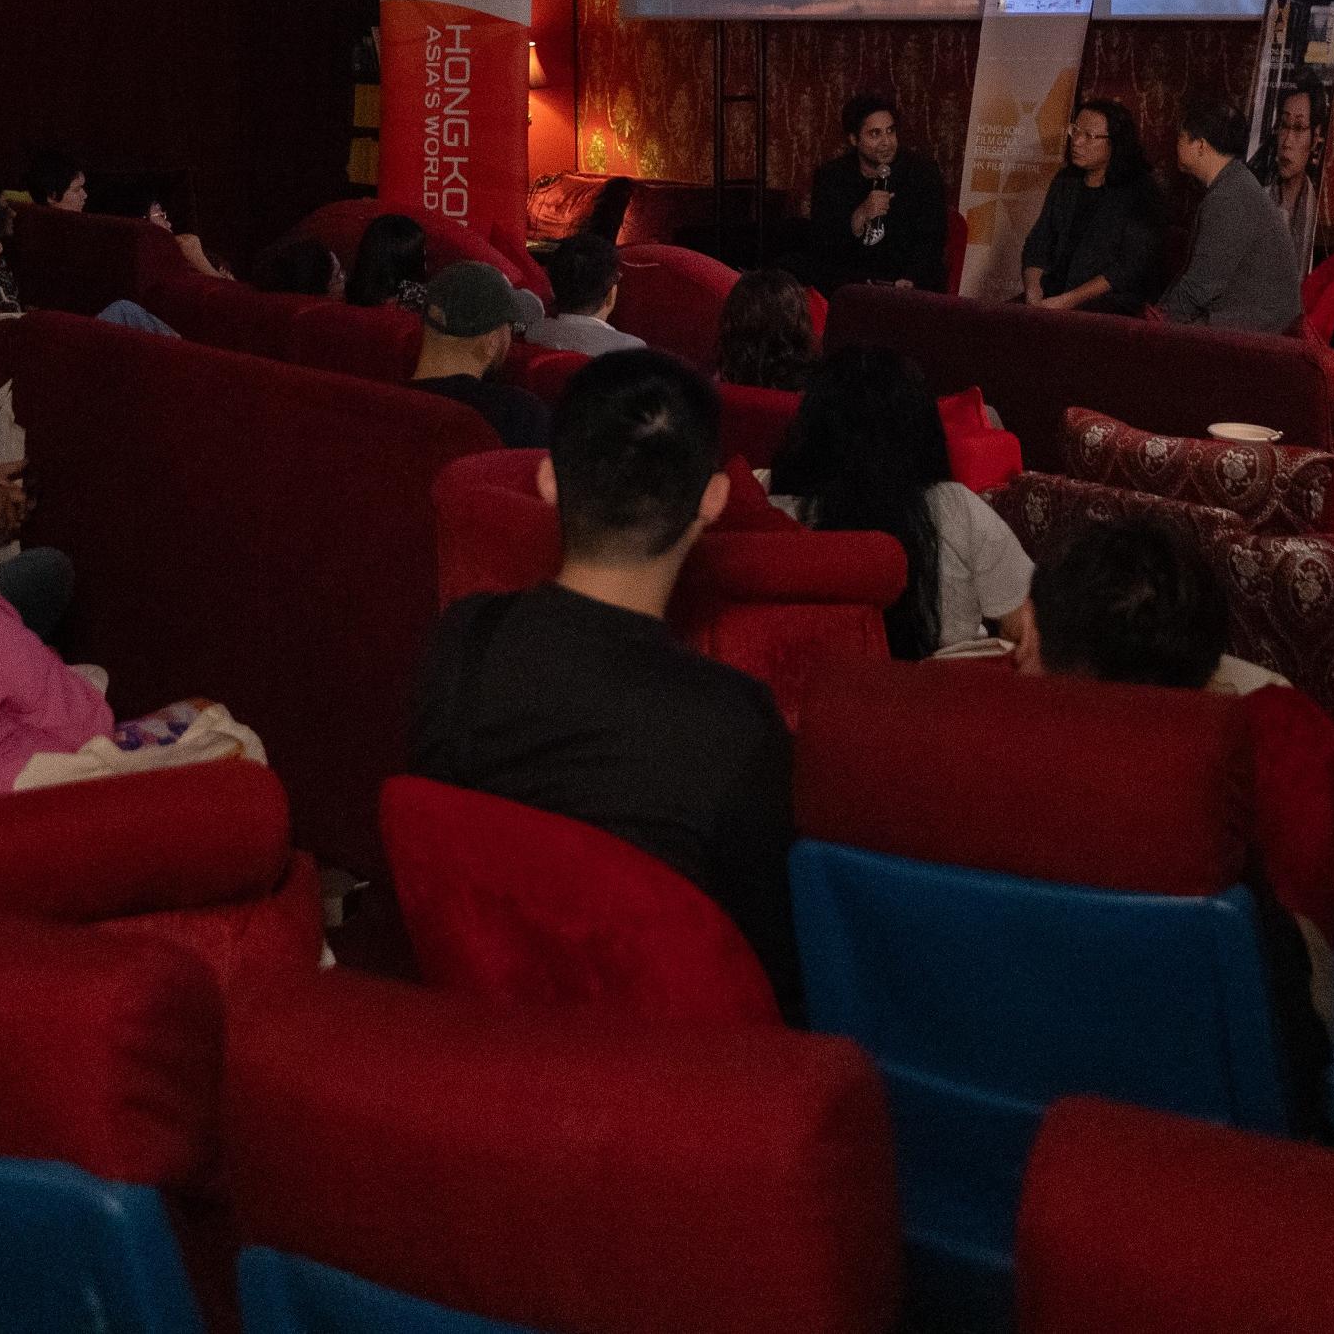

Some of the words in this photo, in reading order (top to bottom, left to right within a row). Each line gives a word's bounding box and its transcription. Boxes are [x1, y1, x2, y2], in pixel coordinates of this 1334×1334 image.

[424, 24, 442, 109] ASIA'S
[442, 23, 471, 148] HONG
[422, 116, 441, 212] WORLD
[441, 156, 469, 228] KO
